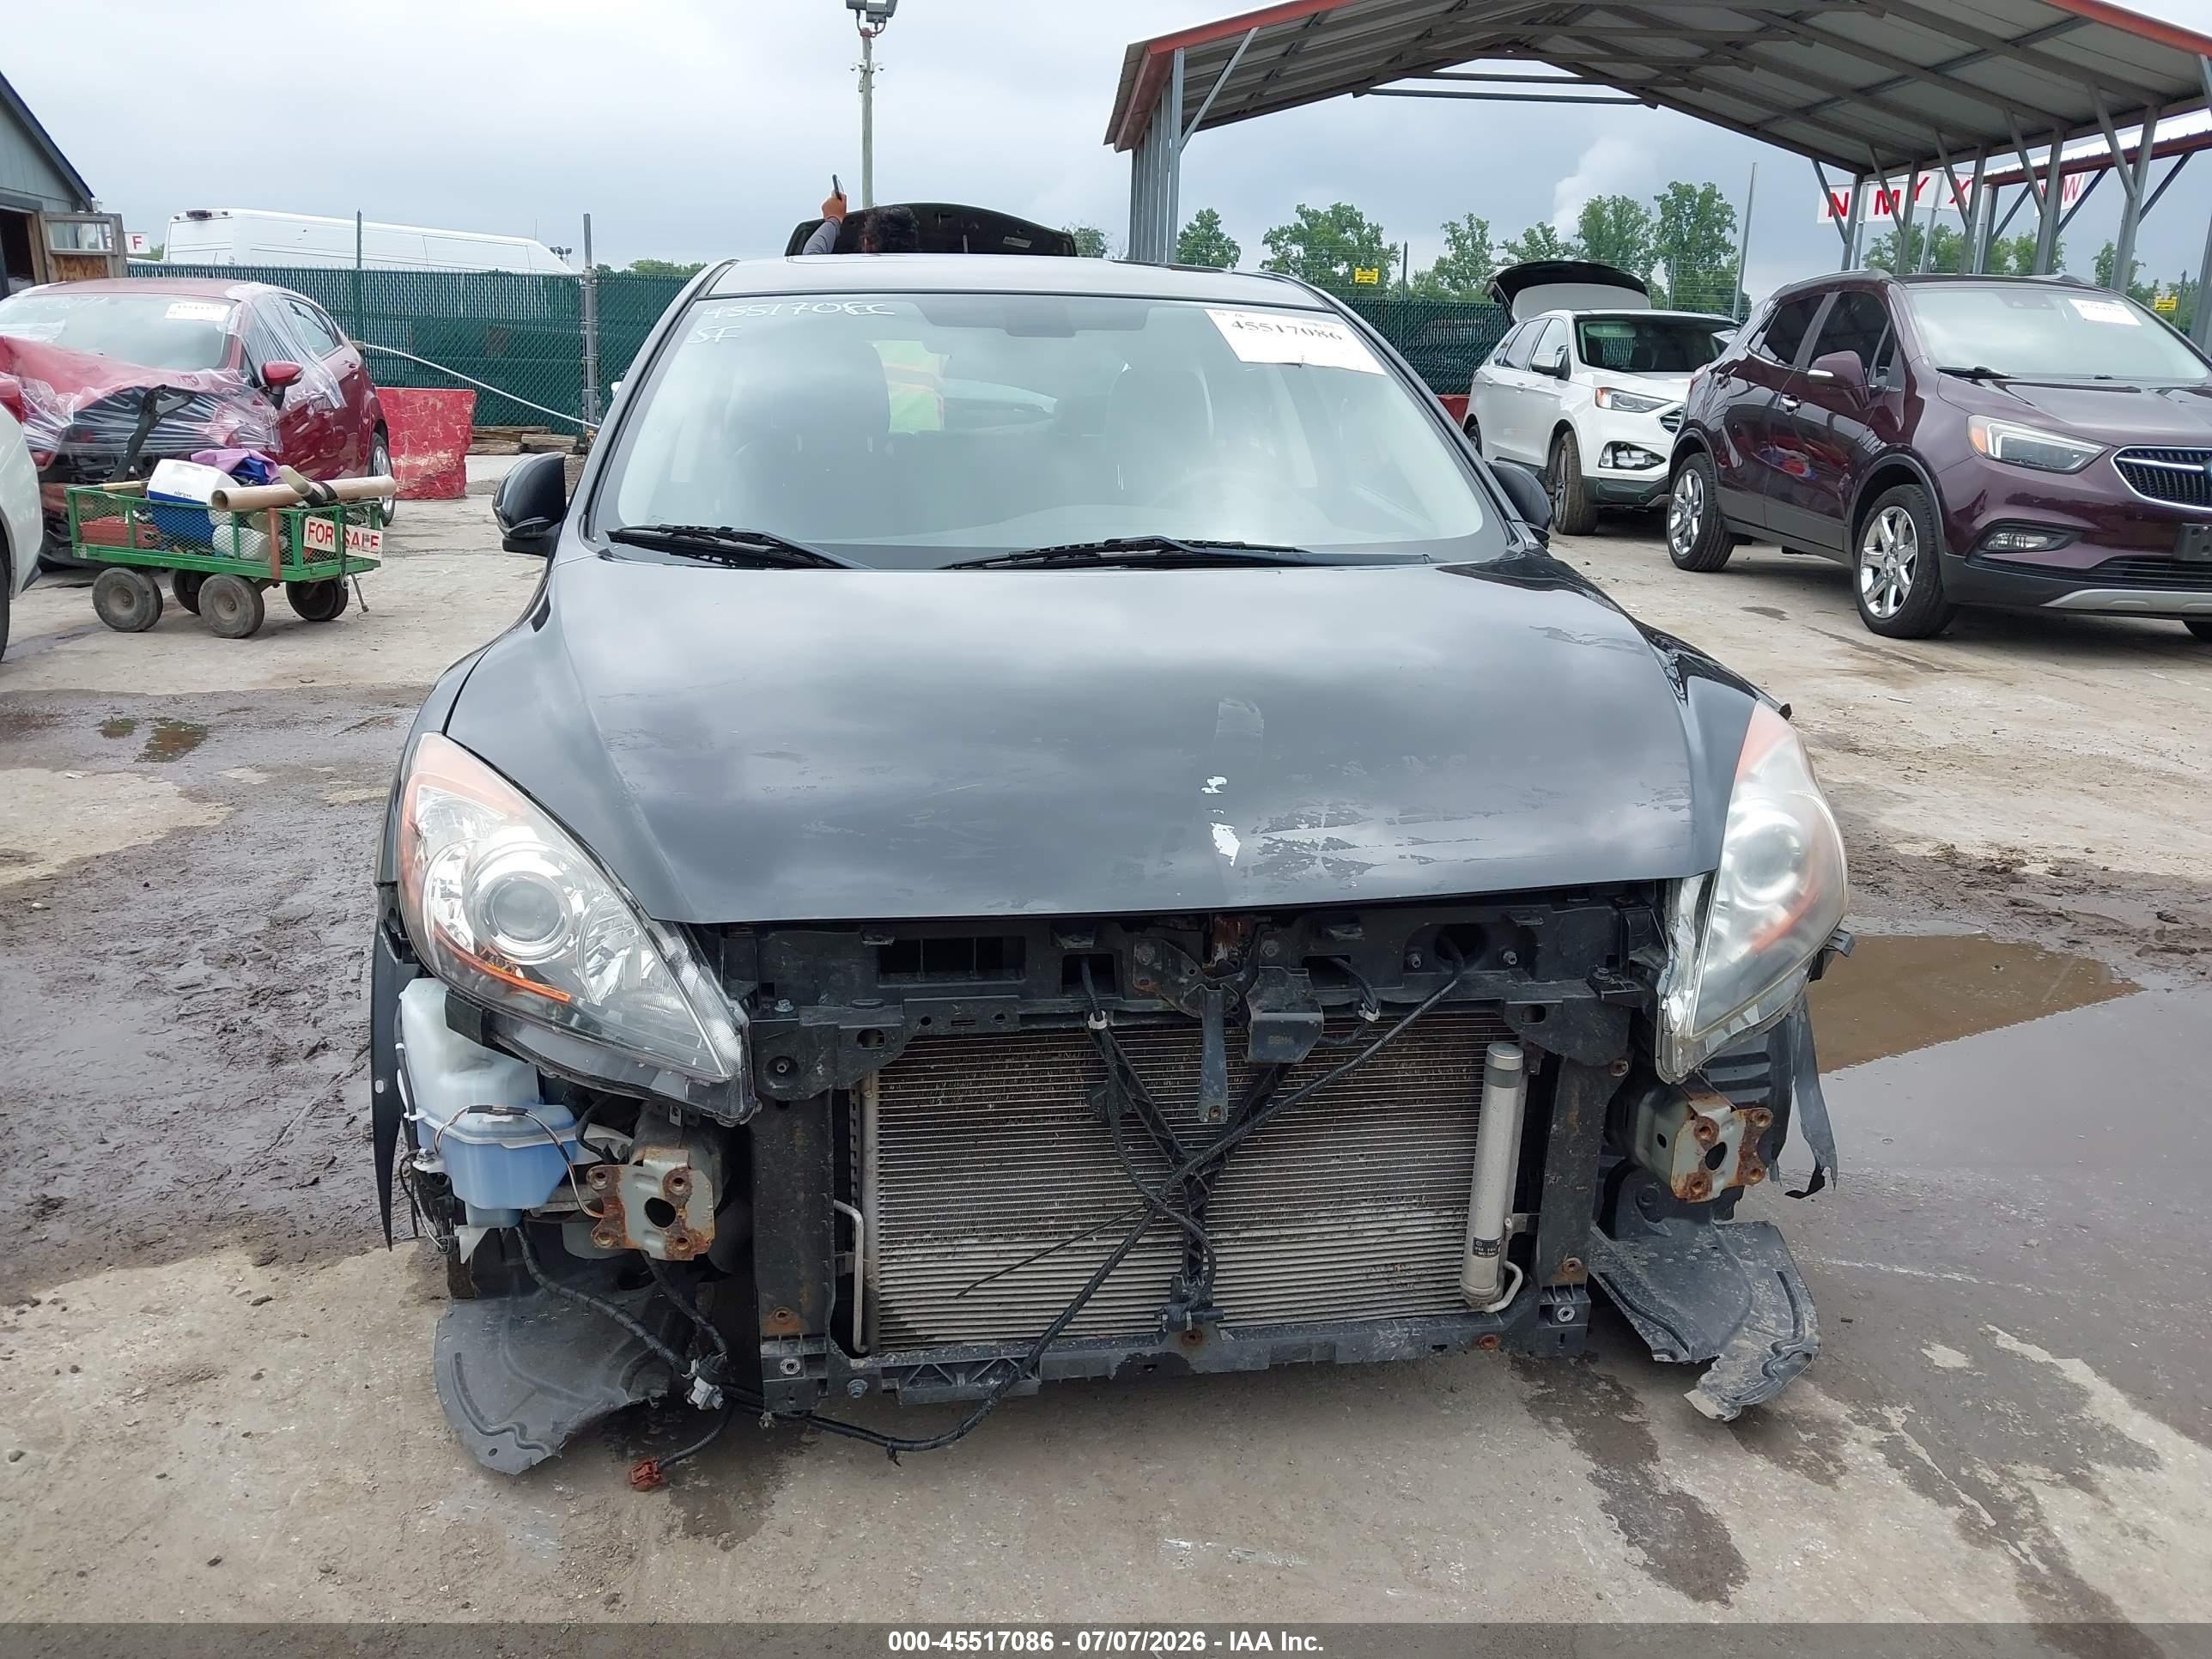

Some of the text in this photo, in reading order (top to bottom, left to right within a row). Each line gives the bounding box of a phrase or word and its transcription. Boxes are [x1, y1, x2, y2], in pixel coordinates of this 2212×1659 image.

[1827, 191, 1850, 217] N
[1875, 189, 1901, 215] M
[132, 235, 143, 250] F
[1231, 319, 1343, 340] 45517086
[307, 521, 334, 546] FOR
